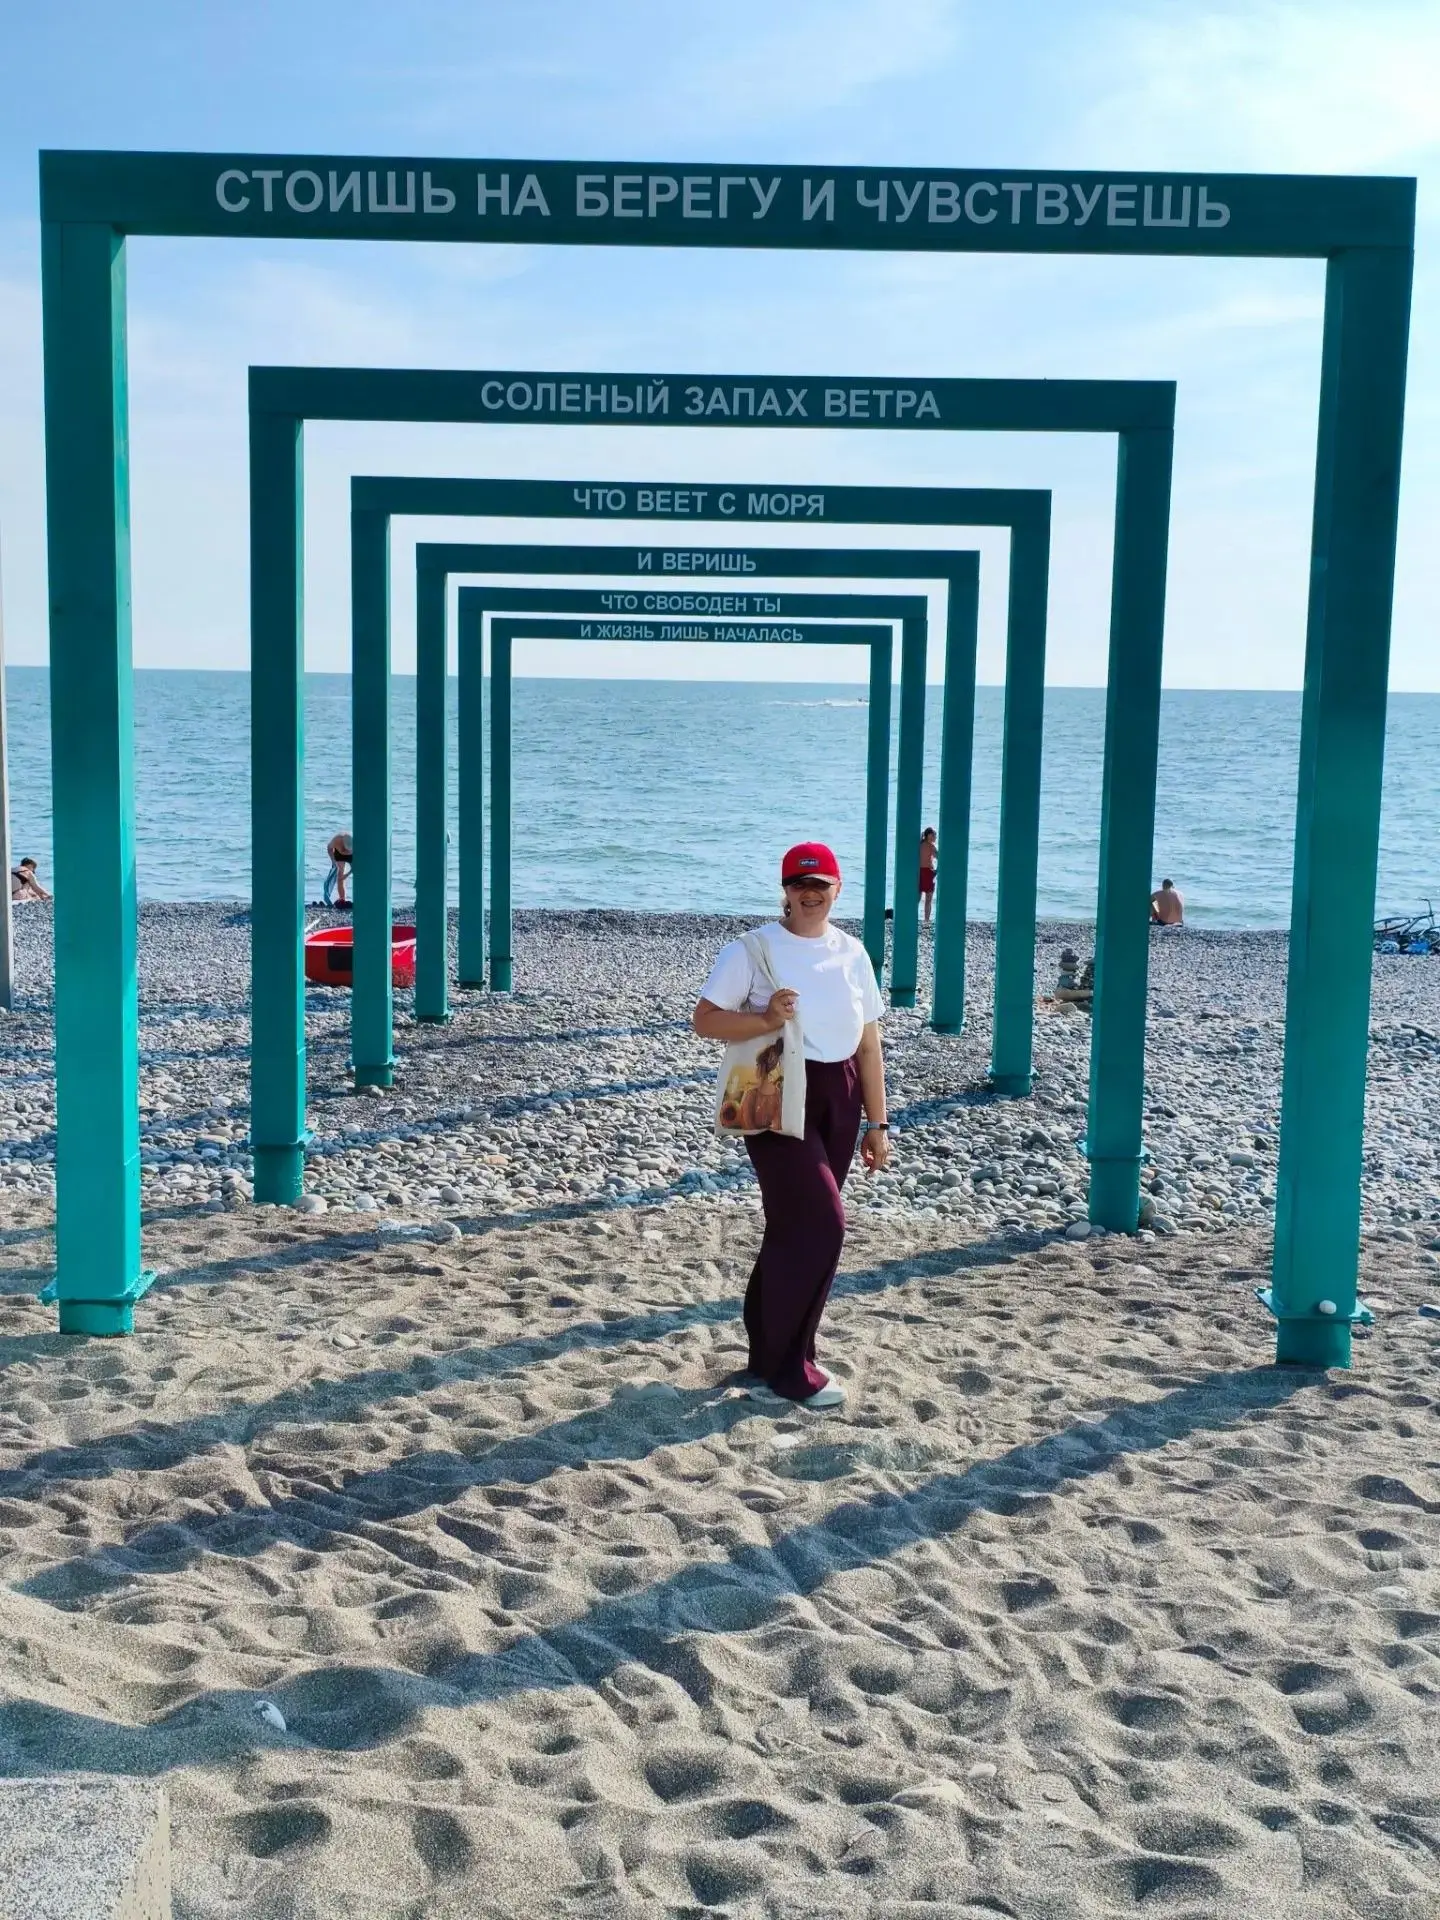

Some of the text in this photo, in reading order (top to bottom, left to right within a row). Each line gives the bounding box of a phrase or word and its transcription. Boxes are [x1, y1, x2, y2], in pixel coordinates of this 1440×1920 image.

[215, 169, 1231, 229] СТОИШЬ НА БЕРЕГУ И ЧУВСТВУЕШЬ
[480, 379, 941, 419] СОЛЕНЫЙ ЗАПАХ ВЕТРА
[573, 488, 825, 517] ЧТО ВЕЕТ С МОРЯ
[637, 552, 757, 572] И ВЕРИШЬ
[600, 594, 781, 615] ЧТО СВОБОДЕН ТЫ
[580, 624, 804, 642] И ЖИЗНЬ ЛИШЬ НАЧАЛАСЬ
